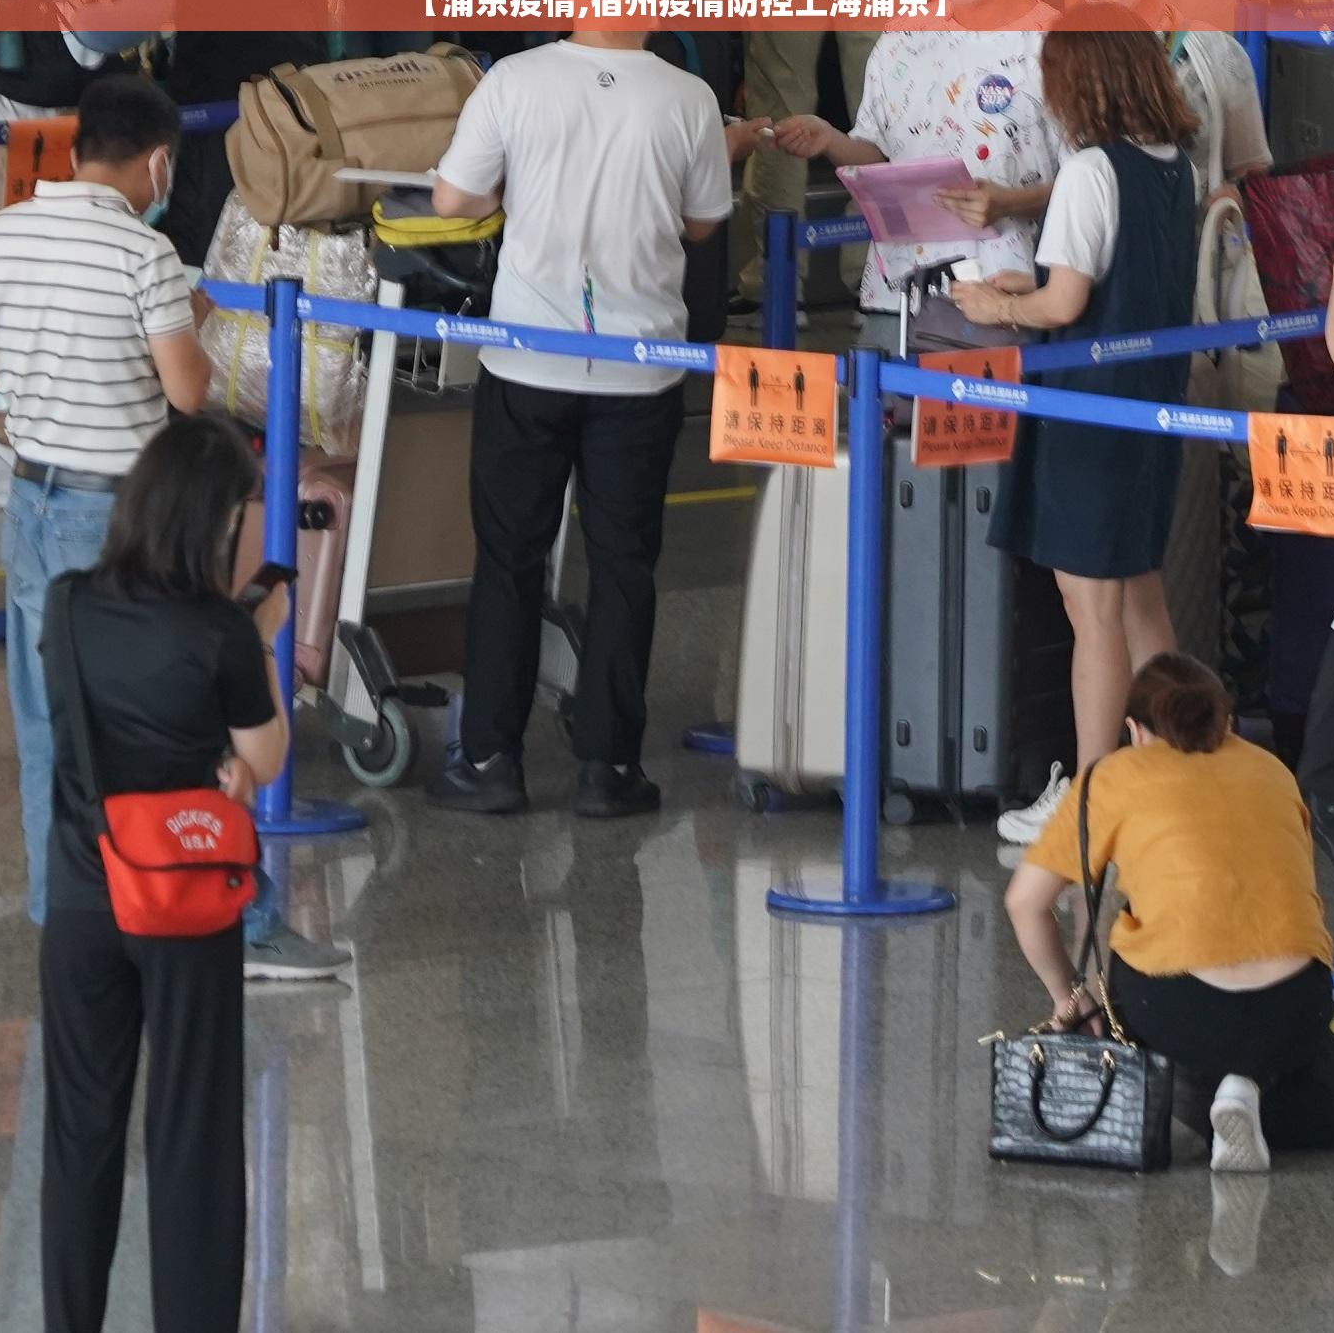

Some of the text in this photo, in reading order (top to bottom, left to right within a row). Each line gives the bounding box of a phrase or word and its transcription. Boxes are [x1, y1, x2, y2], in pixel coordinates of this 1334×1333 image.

[979, 83, 1013, 97] NASA
[723, 409, 827, 438] 请保持距离
[722, 433, 828, 455] Please Keep Distance
[1293, 505, 1317, 519] Keep
[165, 809, 224, 839] DICKIES
